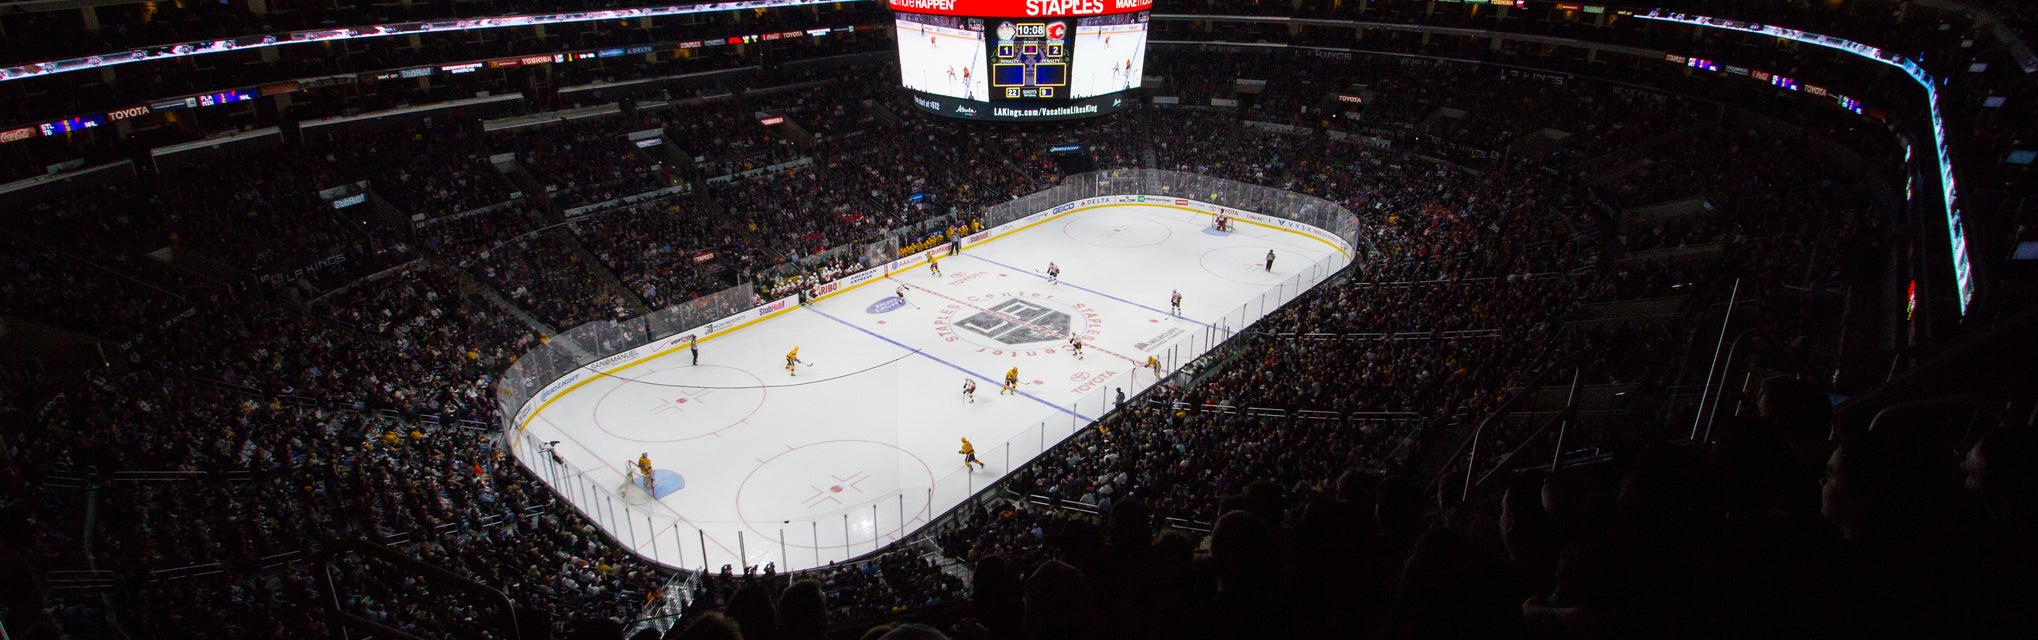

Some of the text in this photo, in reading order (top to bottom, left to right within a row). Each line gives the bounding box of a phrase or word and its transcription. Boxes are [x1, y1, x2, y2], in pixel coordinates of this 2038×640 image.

[1026, 0, 1104, 16] STAPLES
[1018, 25, 1043, 35] 10:08
[1003, 46, 1009, 55] 1
[1052, 46, 1059, 55] 2
[1338, 95, 1363, 103] TOYOTA
[108, 106, 151, 121] TOYOTA
[1087, 197, 1110, 205] DELTA
[1053, 202, 1075, 215] GEICO
[1217, 207, 1239, 216] TYOTA
[933, 303, 960, 344] STAPLES
[1072, 302, 1102, 341] STAPLES
[1070, 370, 1118, 394] TOYOTA
